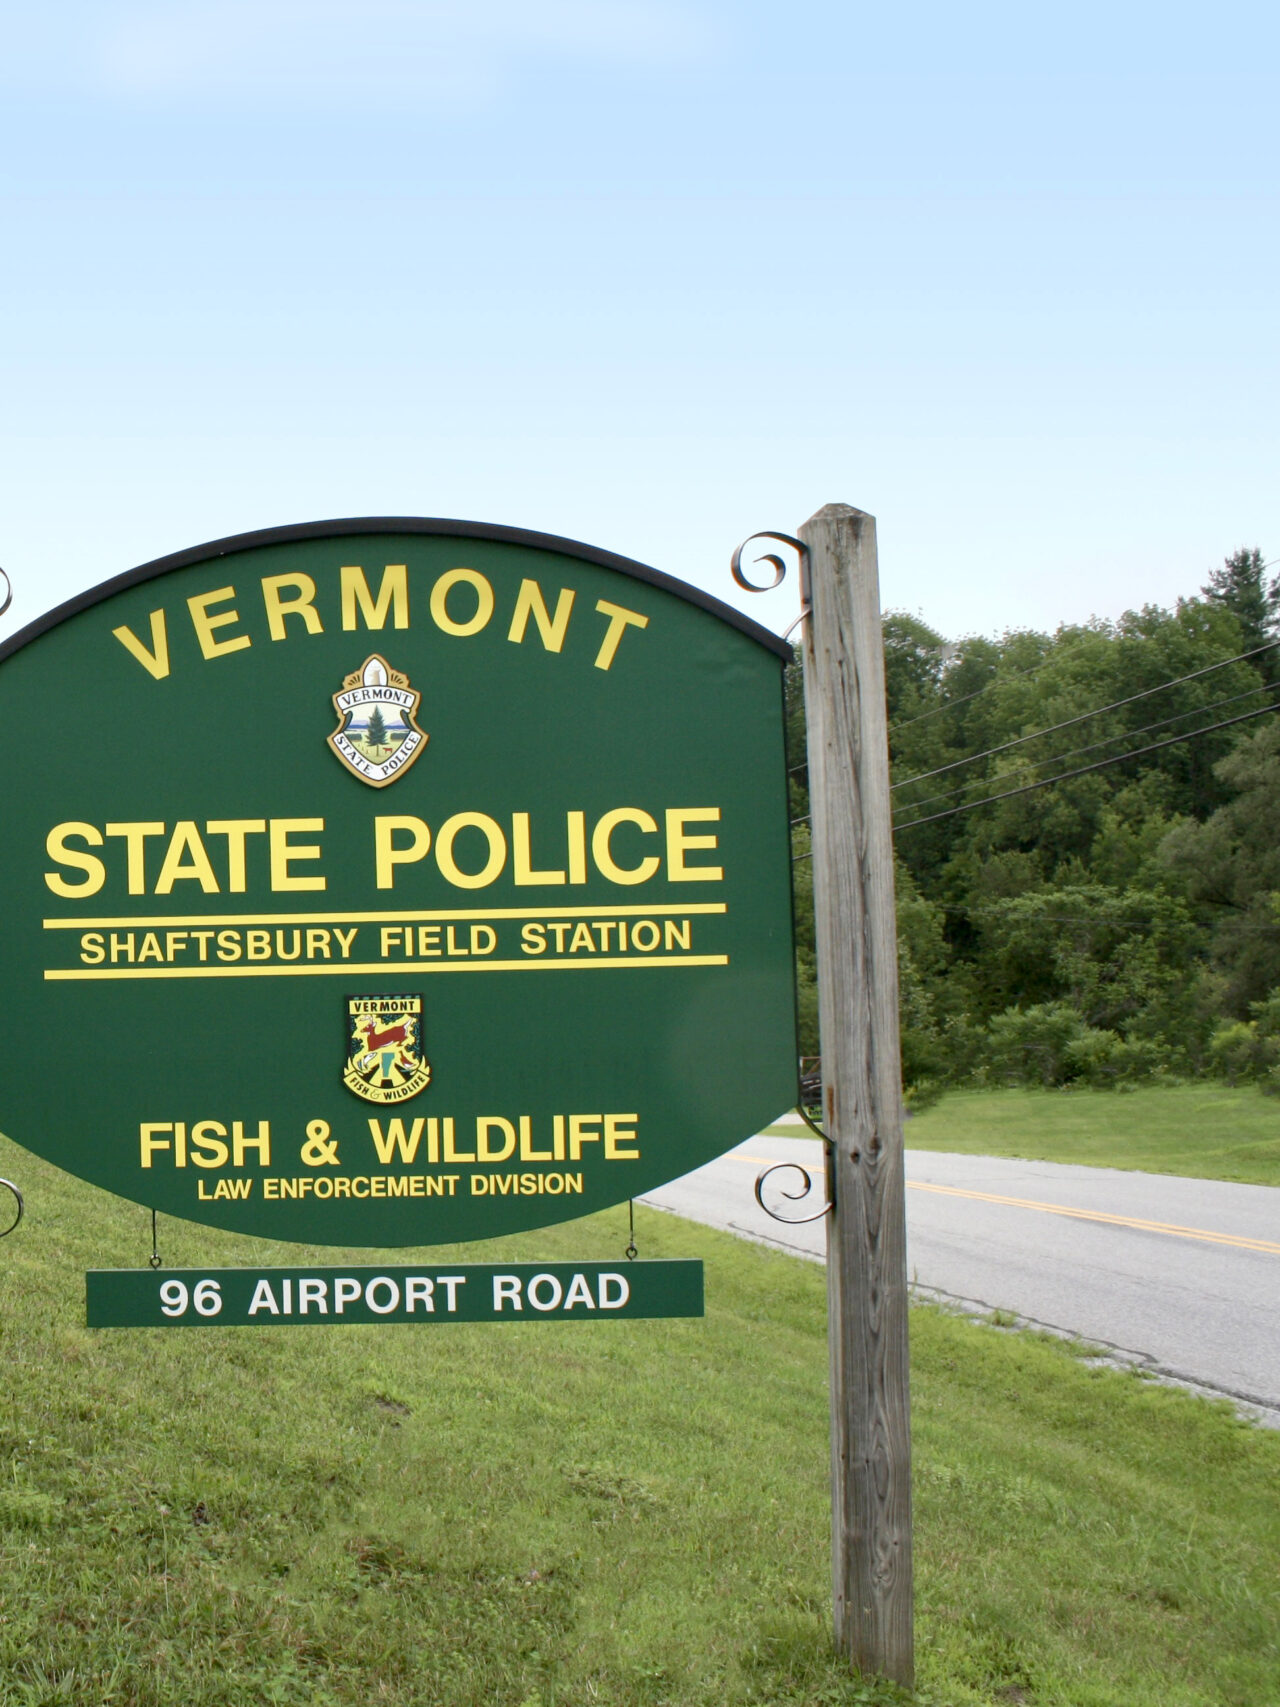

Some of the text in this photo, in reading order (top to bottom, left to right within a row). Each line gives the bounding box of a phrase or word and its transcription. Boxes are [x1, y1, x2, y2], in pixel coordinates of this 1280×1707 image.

[111, 564, 650, 681] VERMONT
[341, 688, 412, 706] VERMONT
[336, 733, 419, 776] STATE POLICE
[44, 807, 724, 899] STATE POLICE
[80, 919, 691, 965] SHAFTSBURY FIELD STATION
[353, 1000, 415, 1012] VERMONT
[349, 1075, 426, 1101] FISH & WILDLIFE
[139, 1113, 640, 1169] FISH & WILDLIFE
[197, 1172, 584, 1200] LAW ENFORCEMENT DIVISION
[160, 1273, 630, 1317] 96 AIRPORT ROAD
